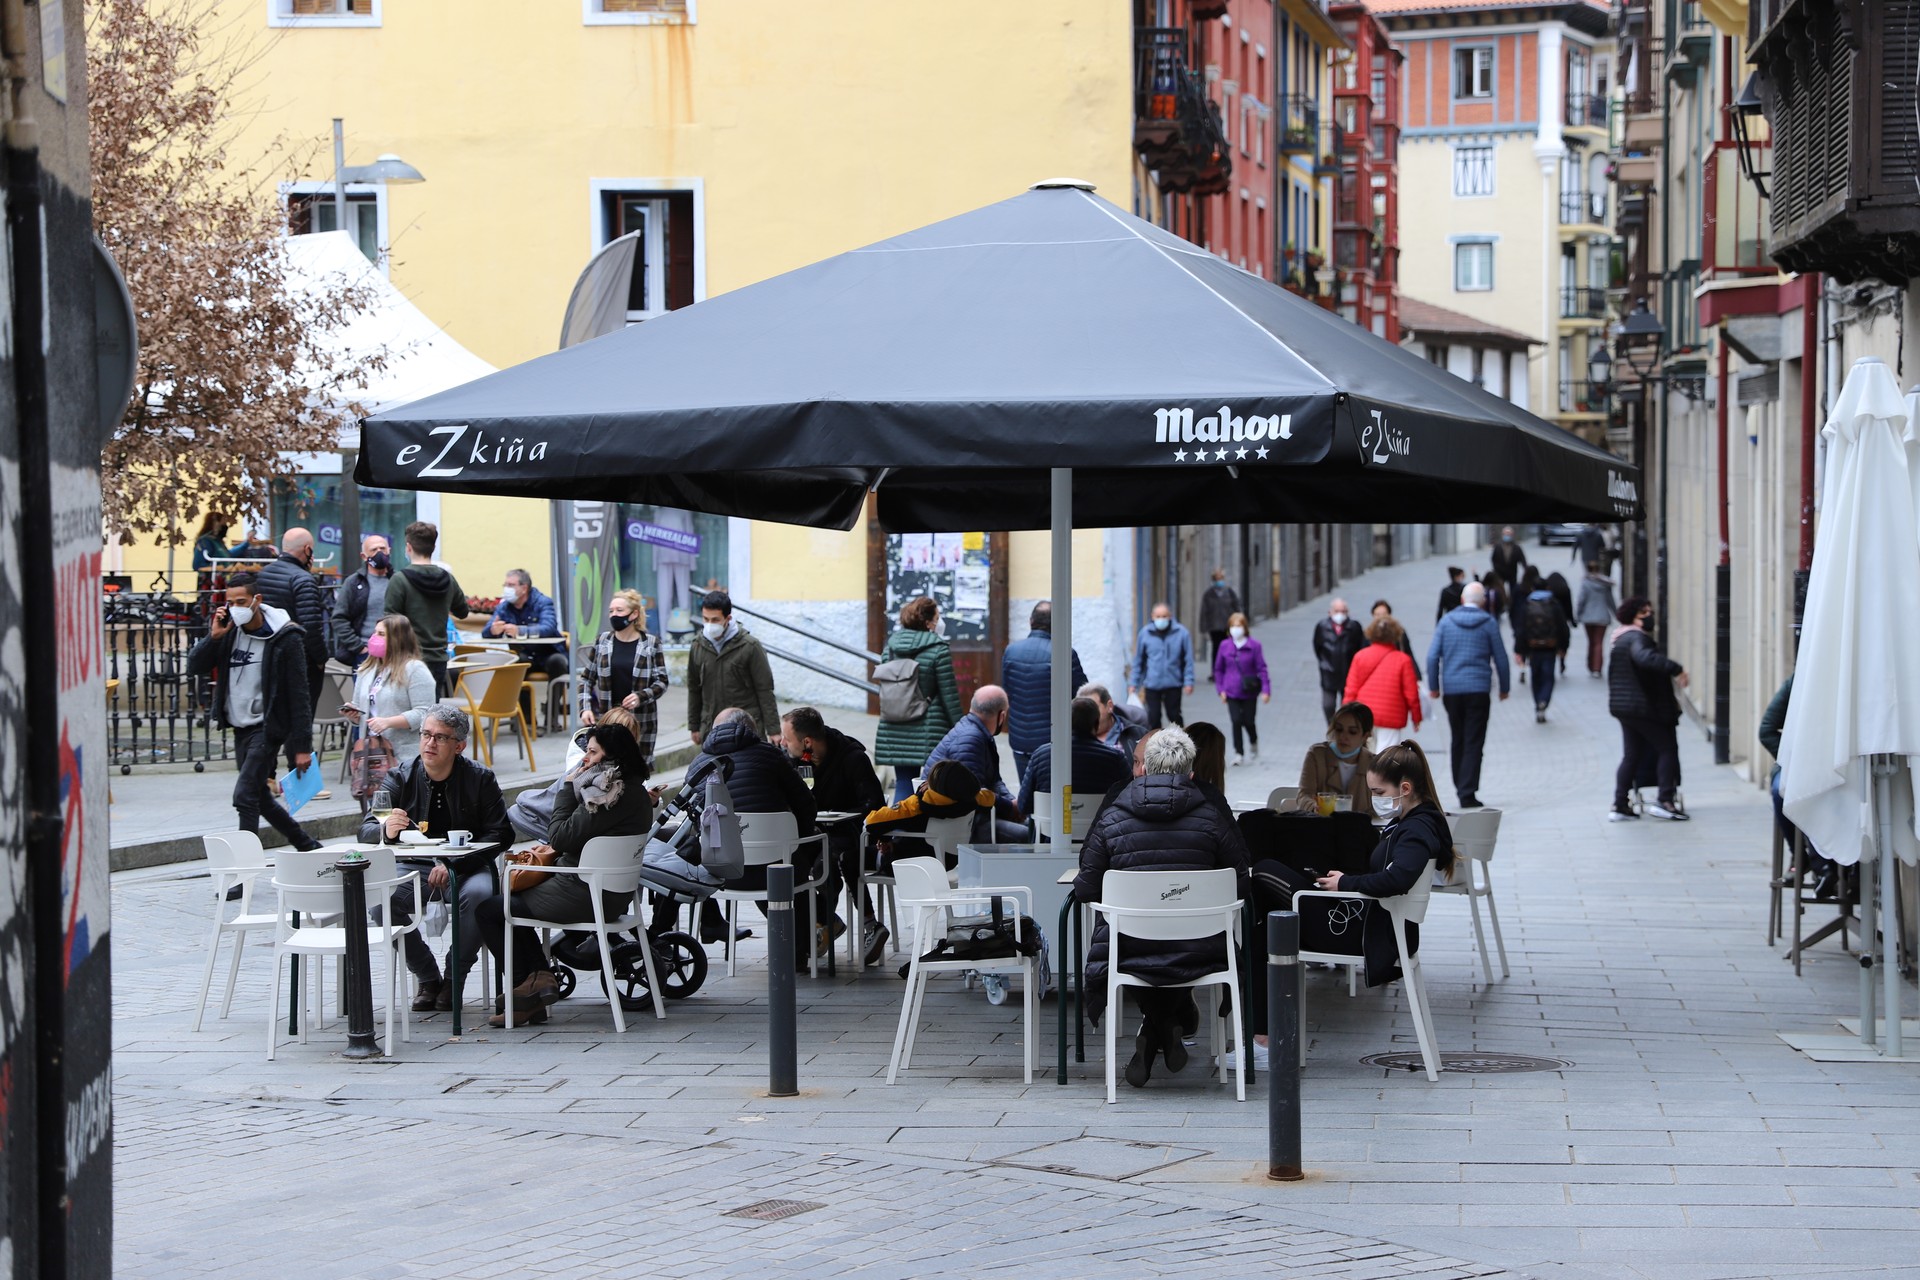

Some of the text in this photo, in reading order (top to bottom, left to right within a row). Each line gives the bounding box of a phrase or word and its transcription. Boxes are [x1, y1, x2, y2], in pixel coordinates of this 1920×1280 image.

[1154, 406, 1293, 443] Mahou
[395, 425, 548, 478] eZkiña
[231, 648, 255, 663] NIKE
[1160, 884, 1190, 900] SanMiguel
